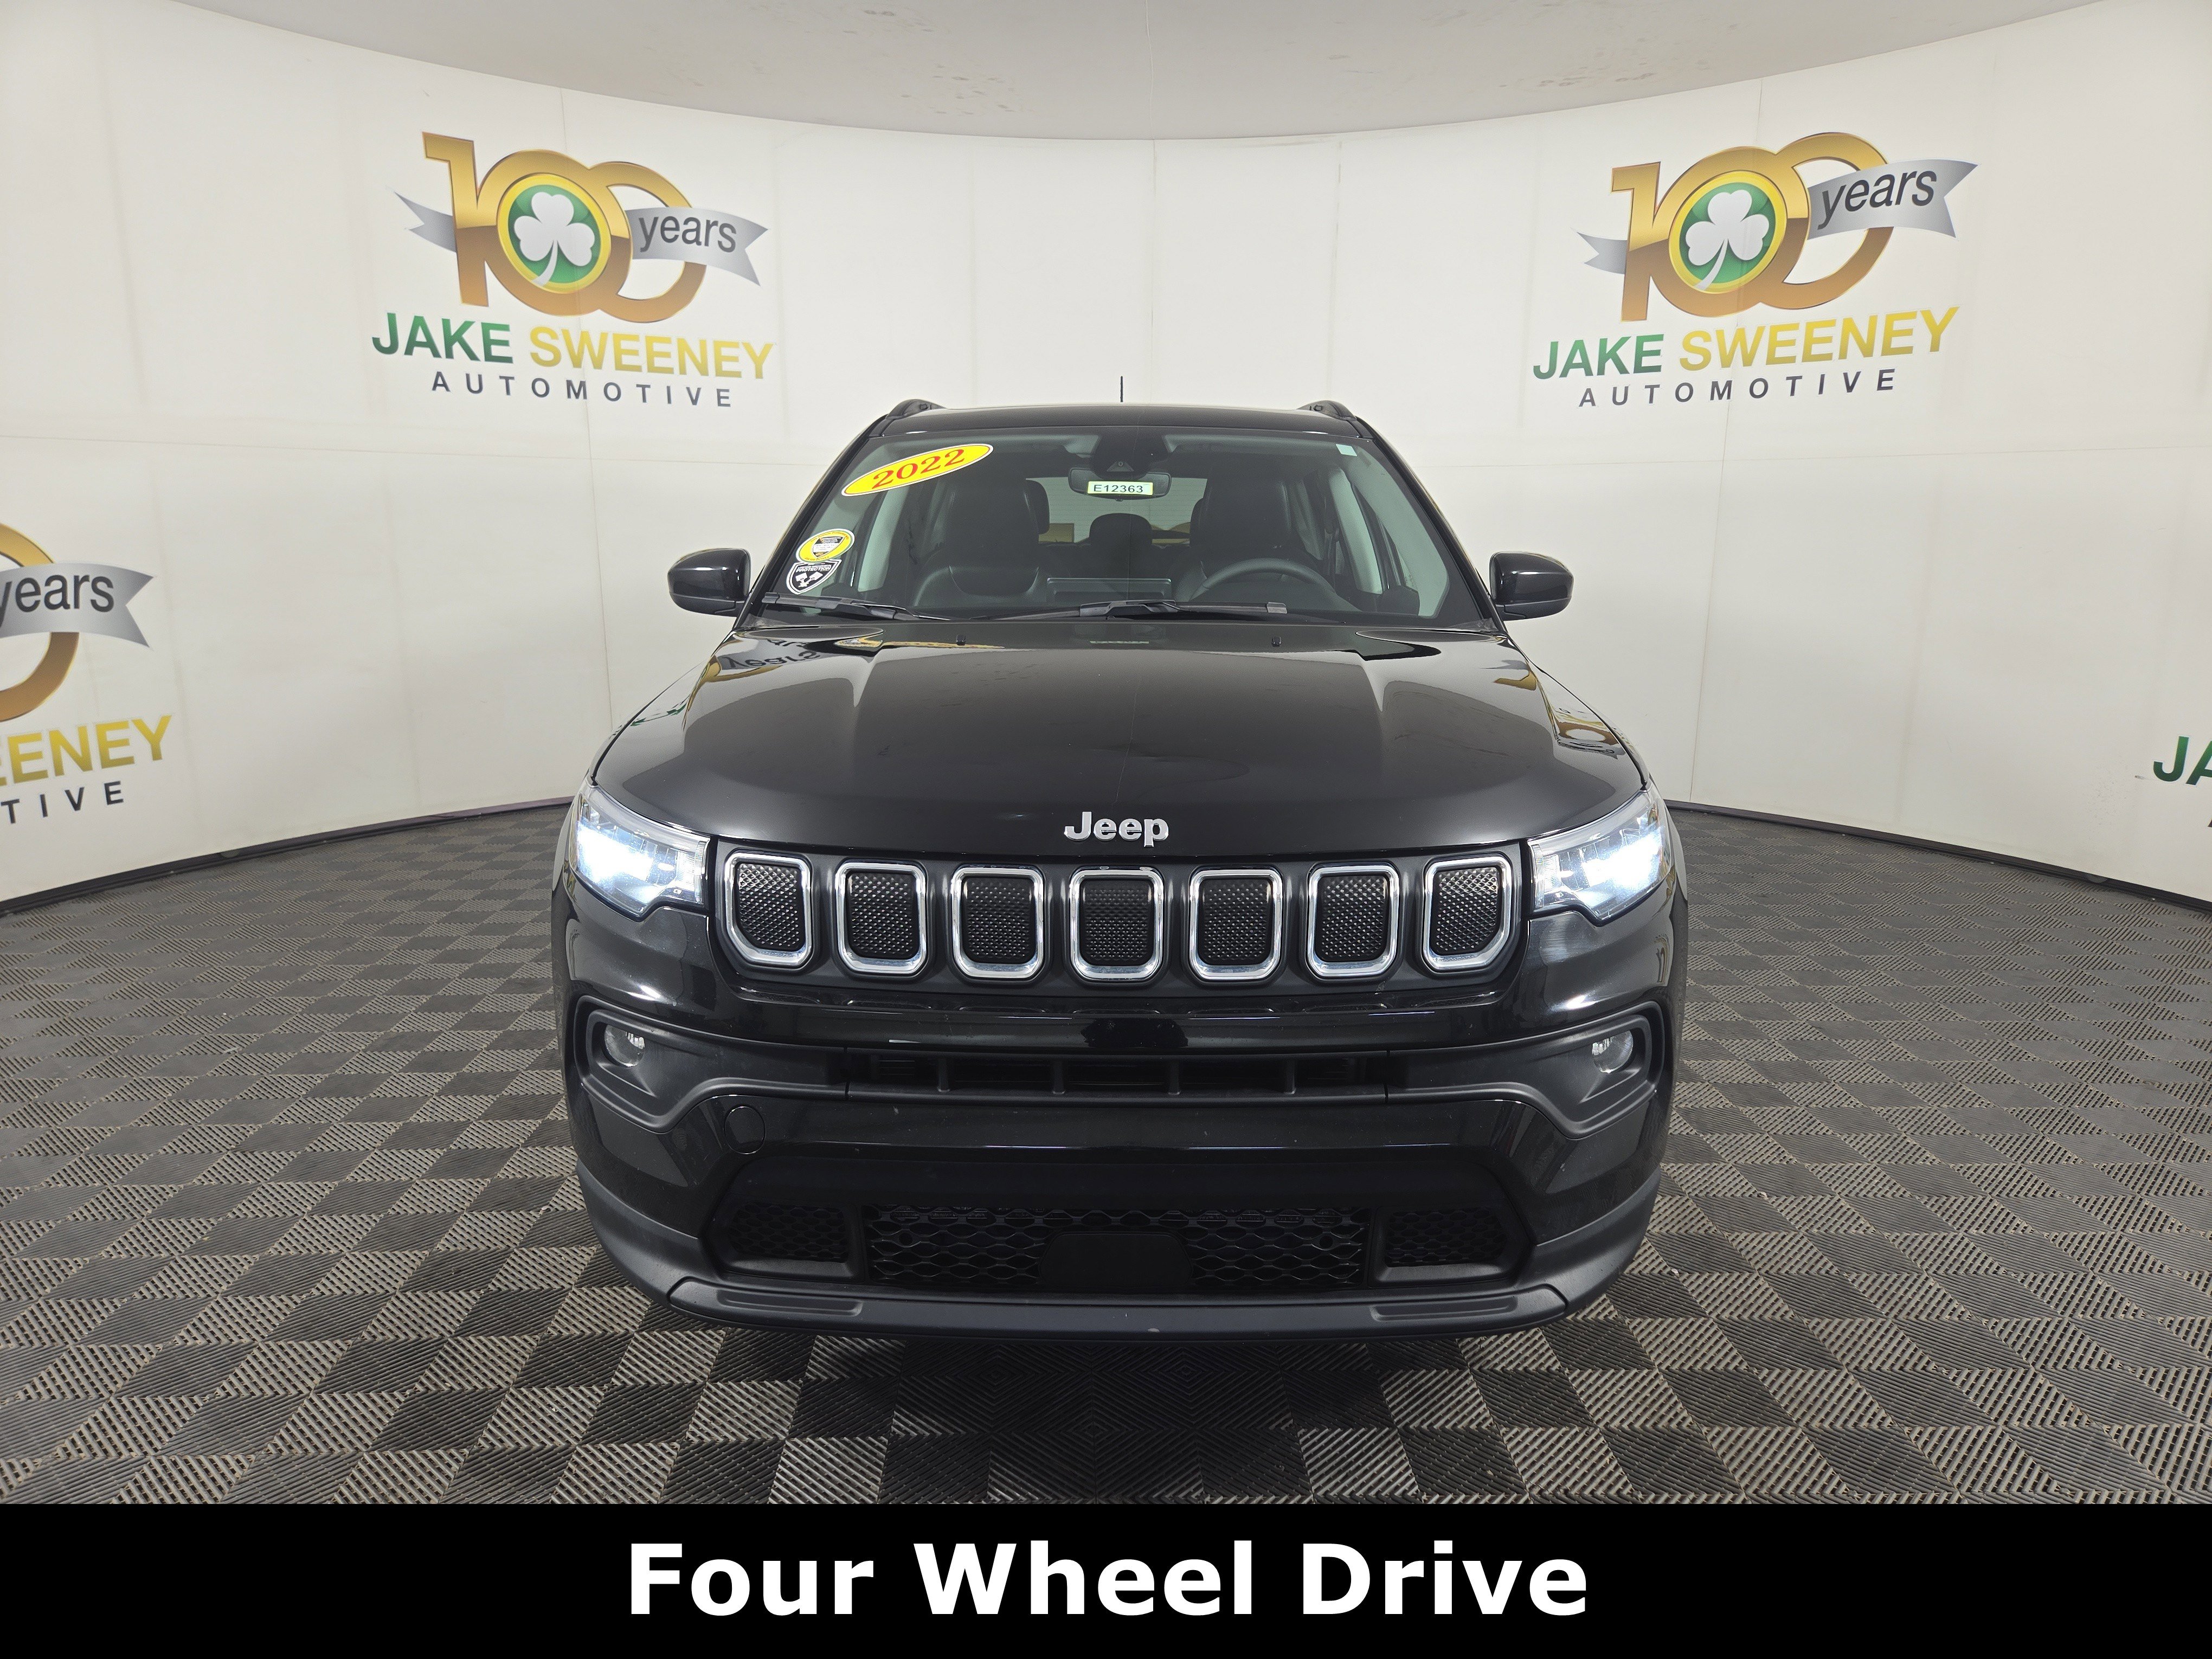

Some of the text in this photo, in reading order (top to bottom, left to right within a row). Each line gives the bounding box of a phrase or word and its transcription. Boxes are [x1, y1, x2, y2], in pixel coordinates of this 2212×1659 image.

[1817, 170, 1938, 230] years
[639, 215, 737, 253] years
[372, 312, 774, 379] JAKE SWEENEY
[1533, 306, 1960, 380] JAKE SWEENEY
[432, 371, 731, 408] AUTOMOTIVE
[1579, 369, 1896, 408] AUTOMOTIVE
[871, 449, 966, 490] 2022
[1094, 484, 1143, 493] E12363
[0, 715, 172, 787] ENEY
[1064, 811, 1169, 847] Jeep
